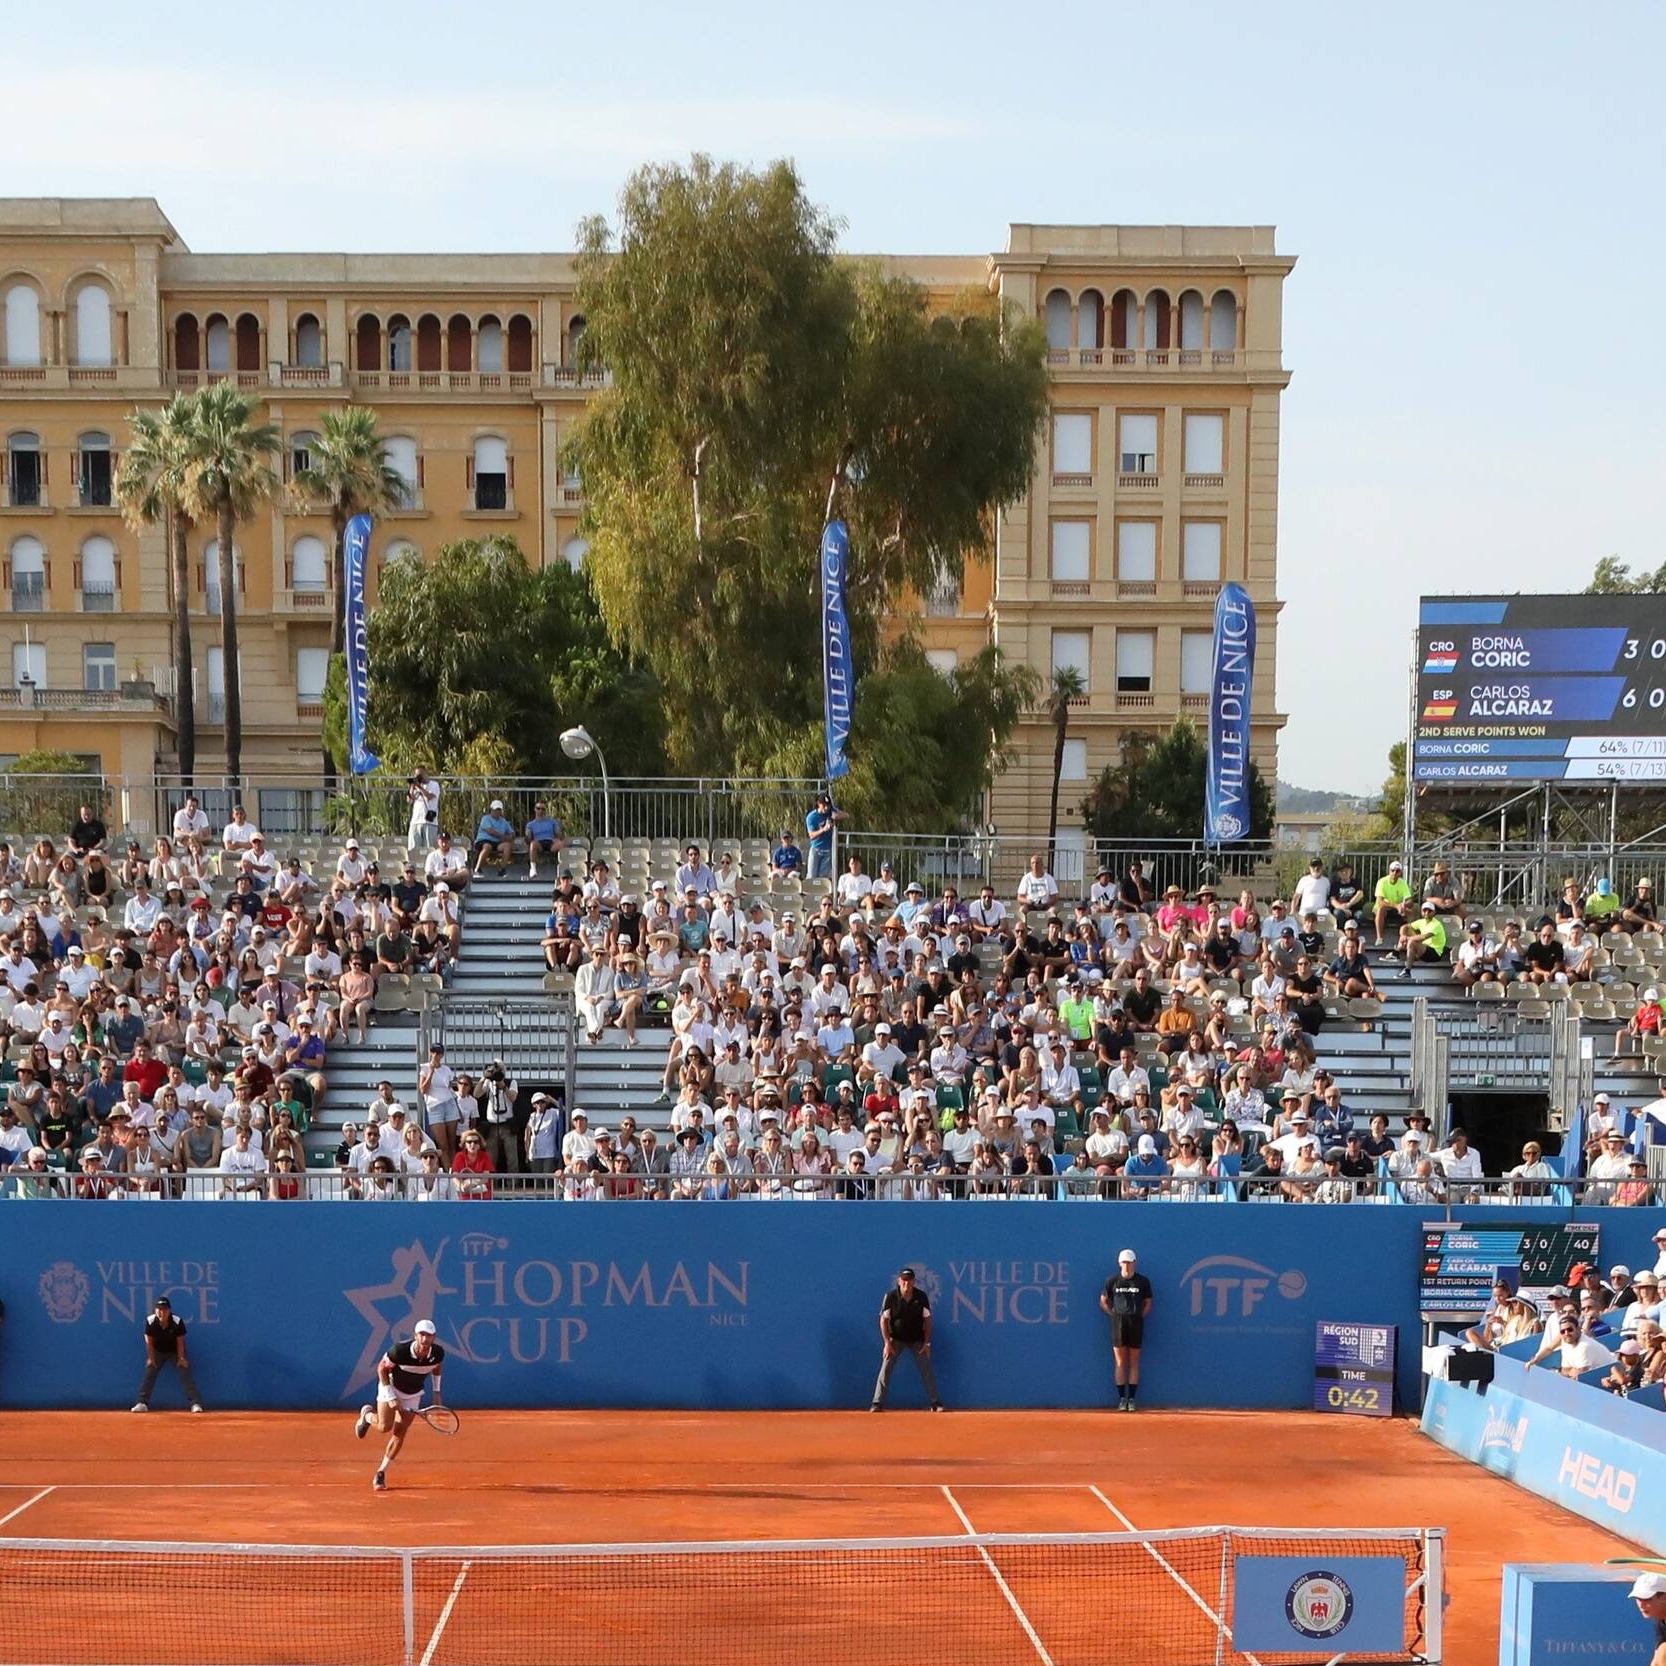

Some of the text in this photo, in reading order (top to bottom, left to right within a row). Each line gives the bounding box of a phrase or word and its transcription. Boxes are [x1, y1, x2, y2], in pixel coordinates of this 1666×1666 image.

[827, 541, 850, 743] VILLE DE NICE
[1430, 642, 1455, 651] CRO
[1471, 637, 1524, 650] BORNA
[1471, 652, 1531, 667] CORIC
[1624, 640, 1638, 659] 3
[1651, 640, 1666, 658] 0
[1433, 690, 1453, 700] ESP
[1470, 686, 1530, 699] CARLOS
[1219, 600, 1247, 808] VILLE DE NICE
[1470, 700, 1553, 716] ALCARAZ
[1623, 689, 1636, 707] 6
[1649, 689, 1665, 707] 0
[1419, 726, 1546, 737] 2ND SERVE POINTS WON
[1419, 740, 1666, 754] BORNA CORIC 64% (7/11)
[1419, 766, 1457, 776] CARLOS
[1458, 766, 1507, 776] ALCARAZ
[1597, 763, 1625, 775] 54%
[463, 1241, 494, 1256] ITF
[1447, 1239, 1589, 1249] CORIC 3 0 40
[95, 1261, 219, 1284] VILLE DE
[948, 1261, 1070, 1284] VILLE DE
[1522, 1262, 1530, 1271] 6
[1538, 1262, 1547, 1271] 0
[460, 1260, 750, 1307] HOPMAN
[951, 1286, 1070, 1323] NICE
[1190, 1278, 1270, 1317] ITF
[709, 1314, 749, 1327] NICE
[1323, 1325, 1359, 1337] RÉGION
[460, 1317, 588, 1364] CUP
[1339, 1337, 1359, 1346] SUD
[1342, 1370, 1366, 1381] TIME
[1327, 1387, 1379, 1409] 0:42
[1558, 1446, 1637, 1513] HEAD
